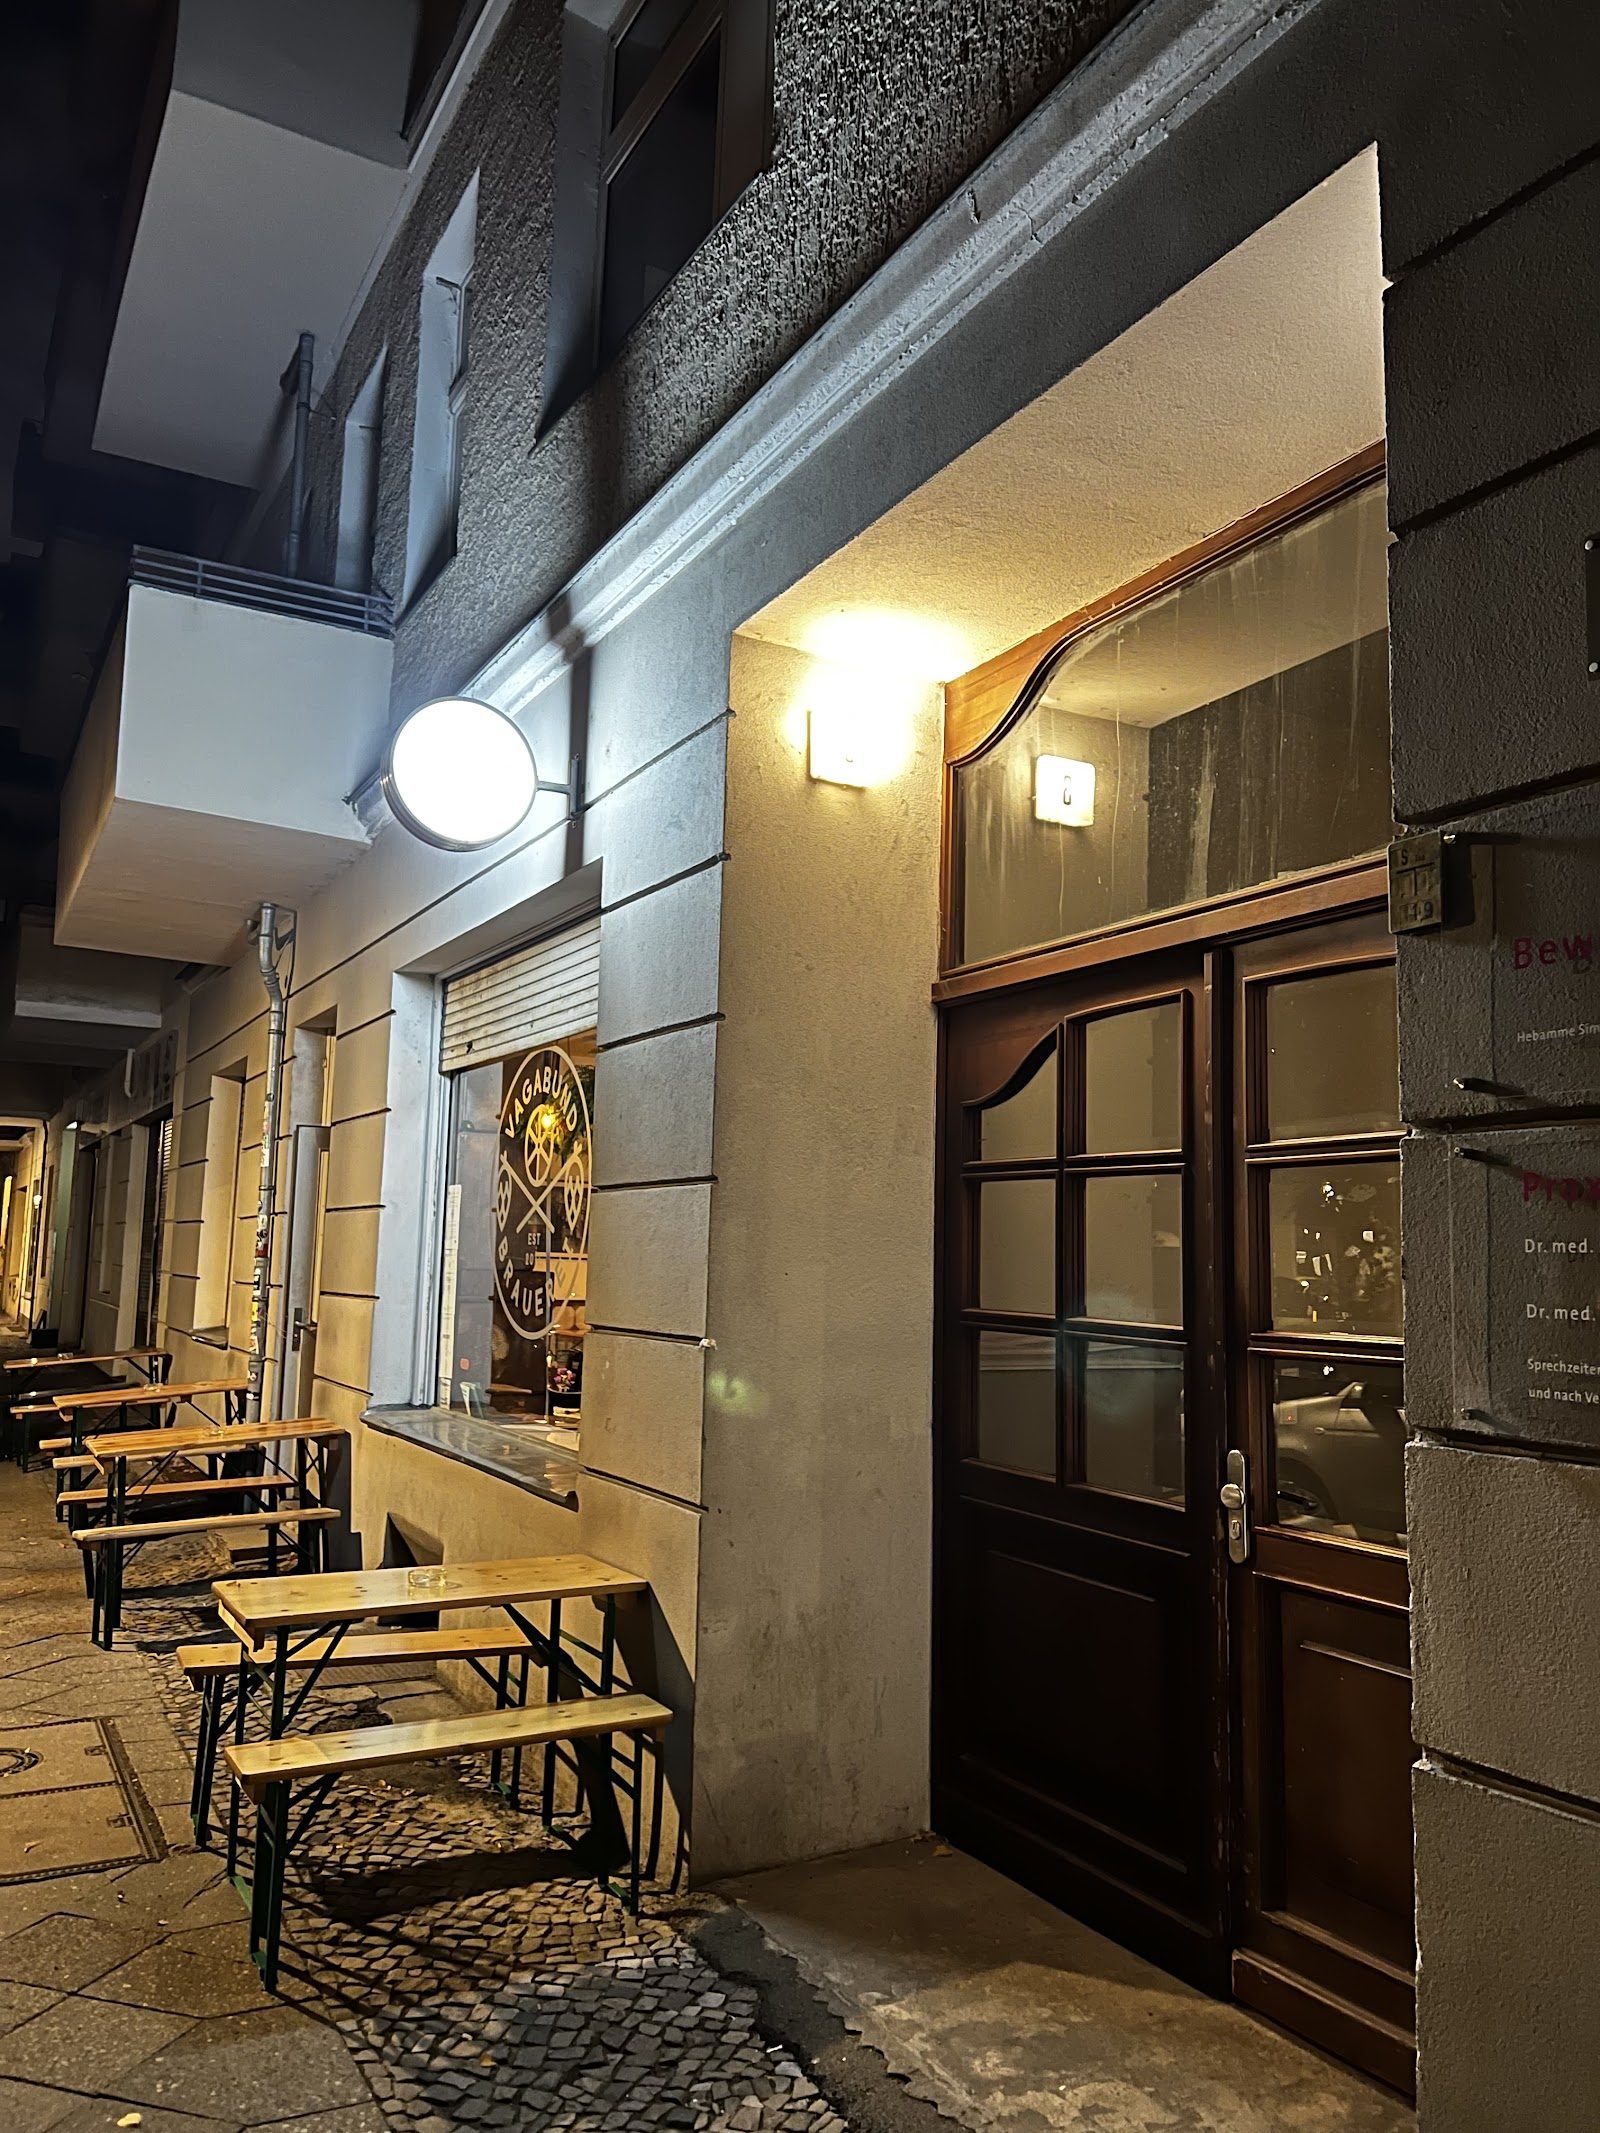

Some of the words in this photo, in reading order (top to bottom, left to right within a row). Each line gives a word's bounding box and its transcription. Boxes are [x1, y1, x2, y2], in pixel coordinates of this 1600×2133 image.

[1516, 1027, 1576, 1043] Hebamme
[504, 1065, 578, 1139] VAGABUND
[526, 1232, 542, 1246] EST
[1524, 1238, 1547, 1254] Dr.
[1551, 1237, 1594, 1255] med.
[1526, 1303, 1550, 1320] Dr.
[1554, 1304, 1596, 1322] med.
[1528, 1386, 1551, 1400] und
[1553, 1389, 1582, 1403] nach
